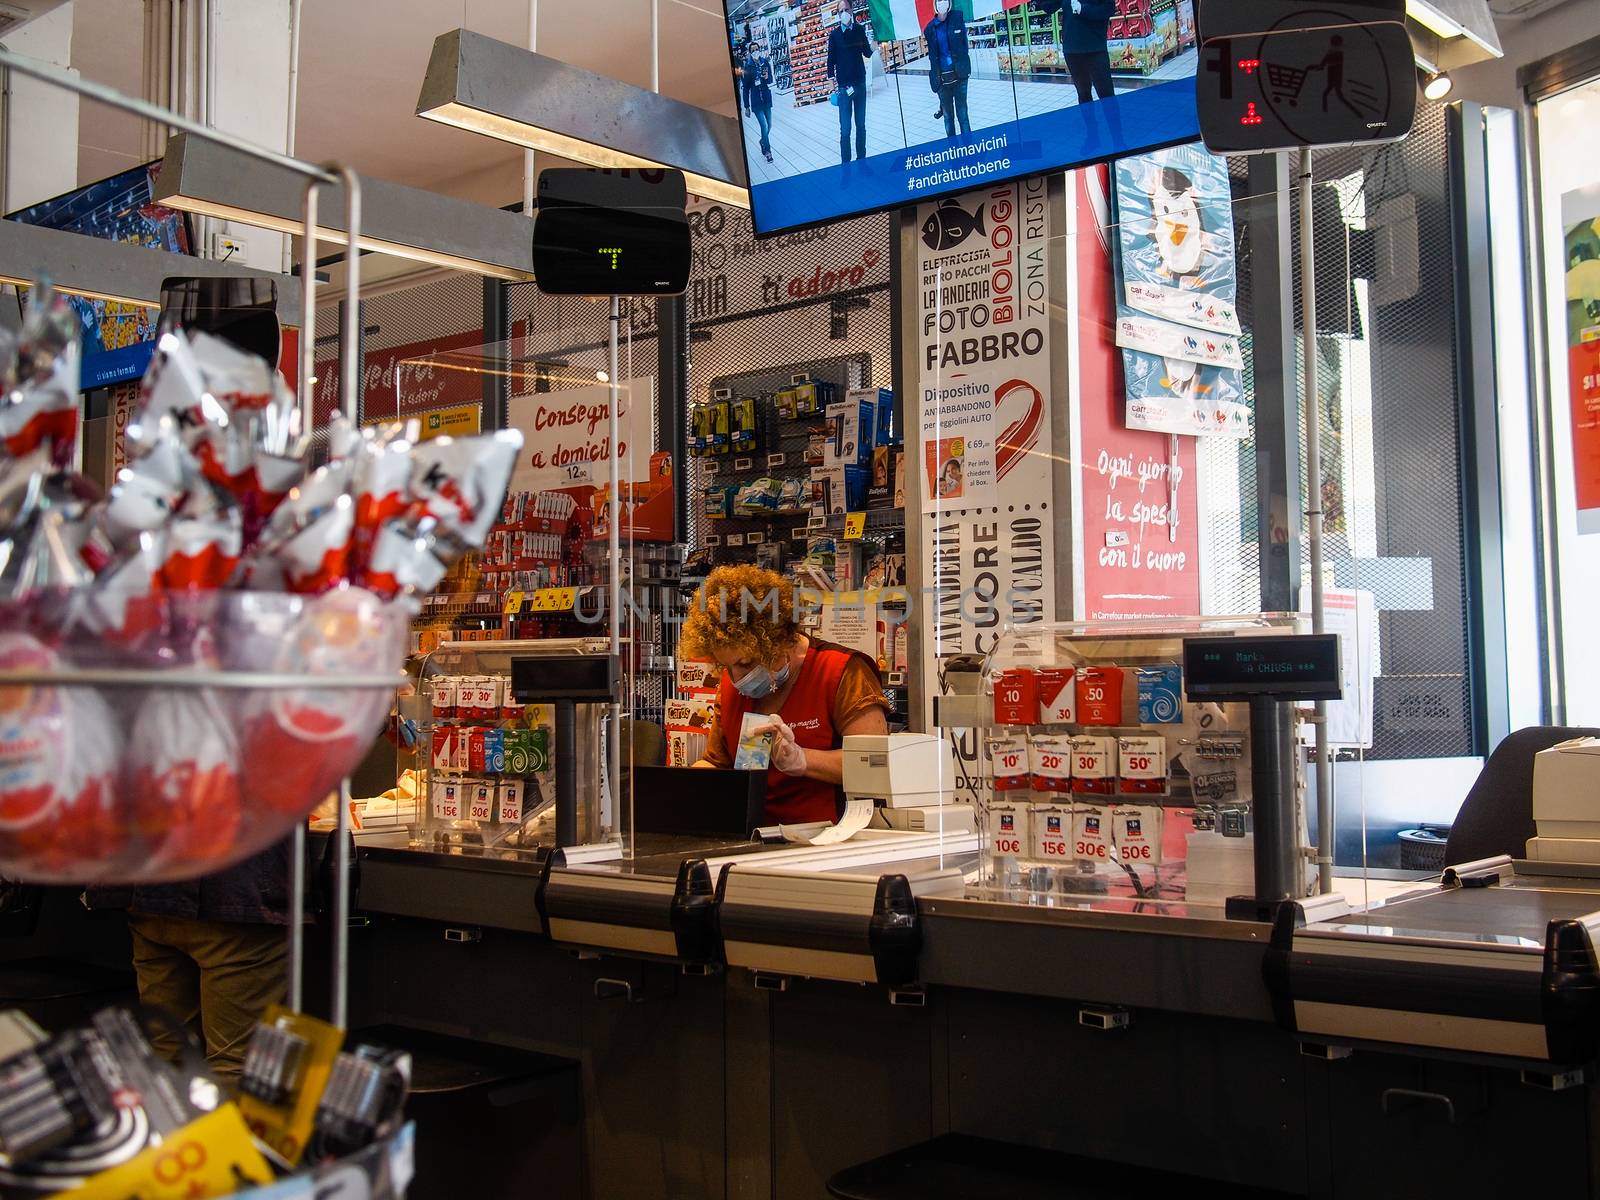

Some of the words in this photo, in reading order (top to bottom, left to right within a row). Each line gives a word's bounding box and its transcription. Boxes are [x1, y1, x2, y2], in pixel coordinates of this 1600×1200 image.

[905, 133, 1008, 171] #distantimavicini
[907, 157, 1011, 191] #andràtuttobene
[923, 248, 991, 271] ELETTRICISTA
[762, 273, 782, 303] ti
[787, 266, 865, 298] adoro
[923, 270, 953, 286] RITRO
[955, 264, 991, 279] PACCHI
[1027, 247, 1045, 317] ZONA
[924, 304, 990, 336] FOTO
[926, 328, 1044, 371] FABBRO
[116, 363, 136, 377] fermati
[938, 417, 970, 430] eggiolini
[970, 413, 992, 424] AUTO
[531, 450, 547, 469] a
[551, 436, 627, 467] domicilo
[967, 468, 991, 478] chiedere
[968, 459, 977, 468] Per
[978, 459, 990, 467] info
[1097, 448, 1133, 490] Ogni
[1104, 494, 1127, 522] la
[1009, 517, 1043, 592] CALDO
[1098, 546, 1128, 569] con
[1131, 542, 1141, 569] il
[1146, 550, 1186, 572] cuore
[972, 522, 1000, 656] CUORE
[1258, 663, 1293, 673] CHIUSA
[1041, 755, 1062, 769] 20€
[1079, 756, 1098, 770] 30€
[1129, 756, 1152, 770] 50€
[471, 806, 489, 818] 30€
[502, 808, 519, 819] 50€
[995, 839, 1020, 853] 10€
[1042, 841, 1066, 855] 15€
[1076, 840, 1106, 858] 30€
[1121, 844, 1151, 860] 50€
